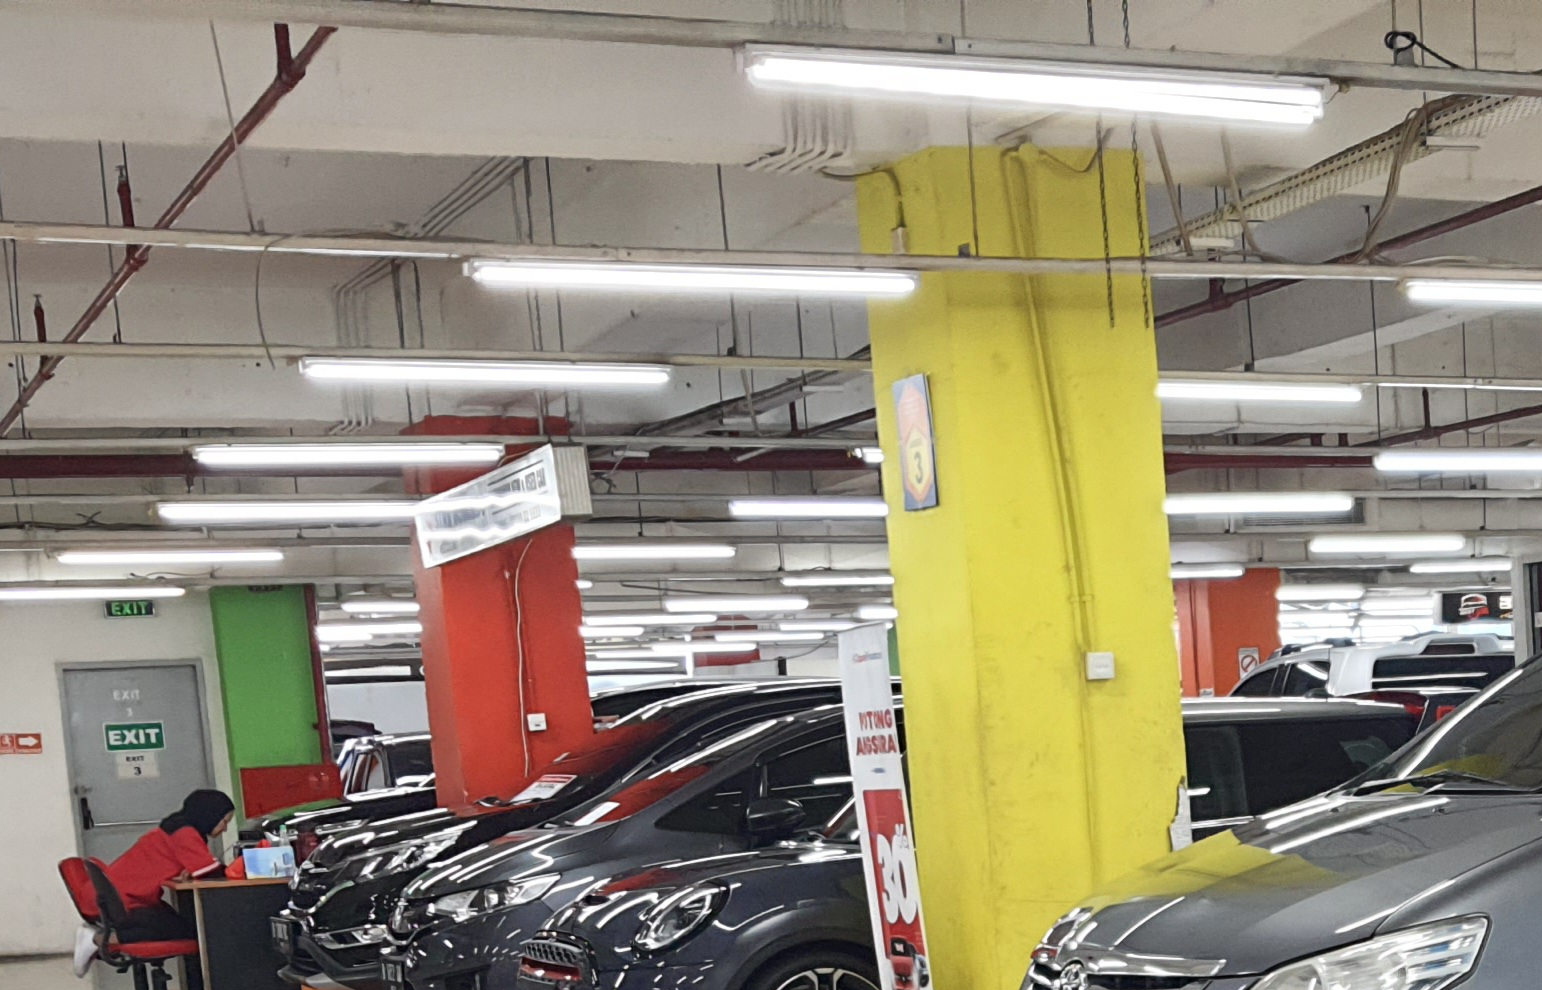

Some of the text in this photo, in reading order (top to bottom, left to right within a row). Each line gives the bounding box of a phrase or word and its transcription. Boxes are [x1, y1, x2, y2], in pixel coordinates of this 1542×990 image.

[914, 451, 924, 484] 3
[111, 602, 149, 615] EXIT
[113, 689, 140, 700] EXIT
[108, 729, 160, 746] EXIT
[133, 766, 142, 776] 3
